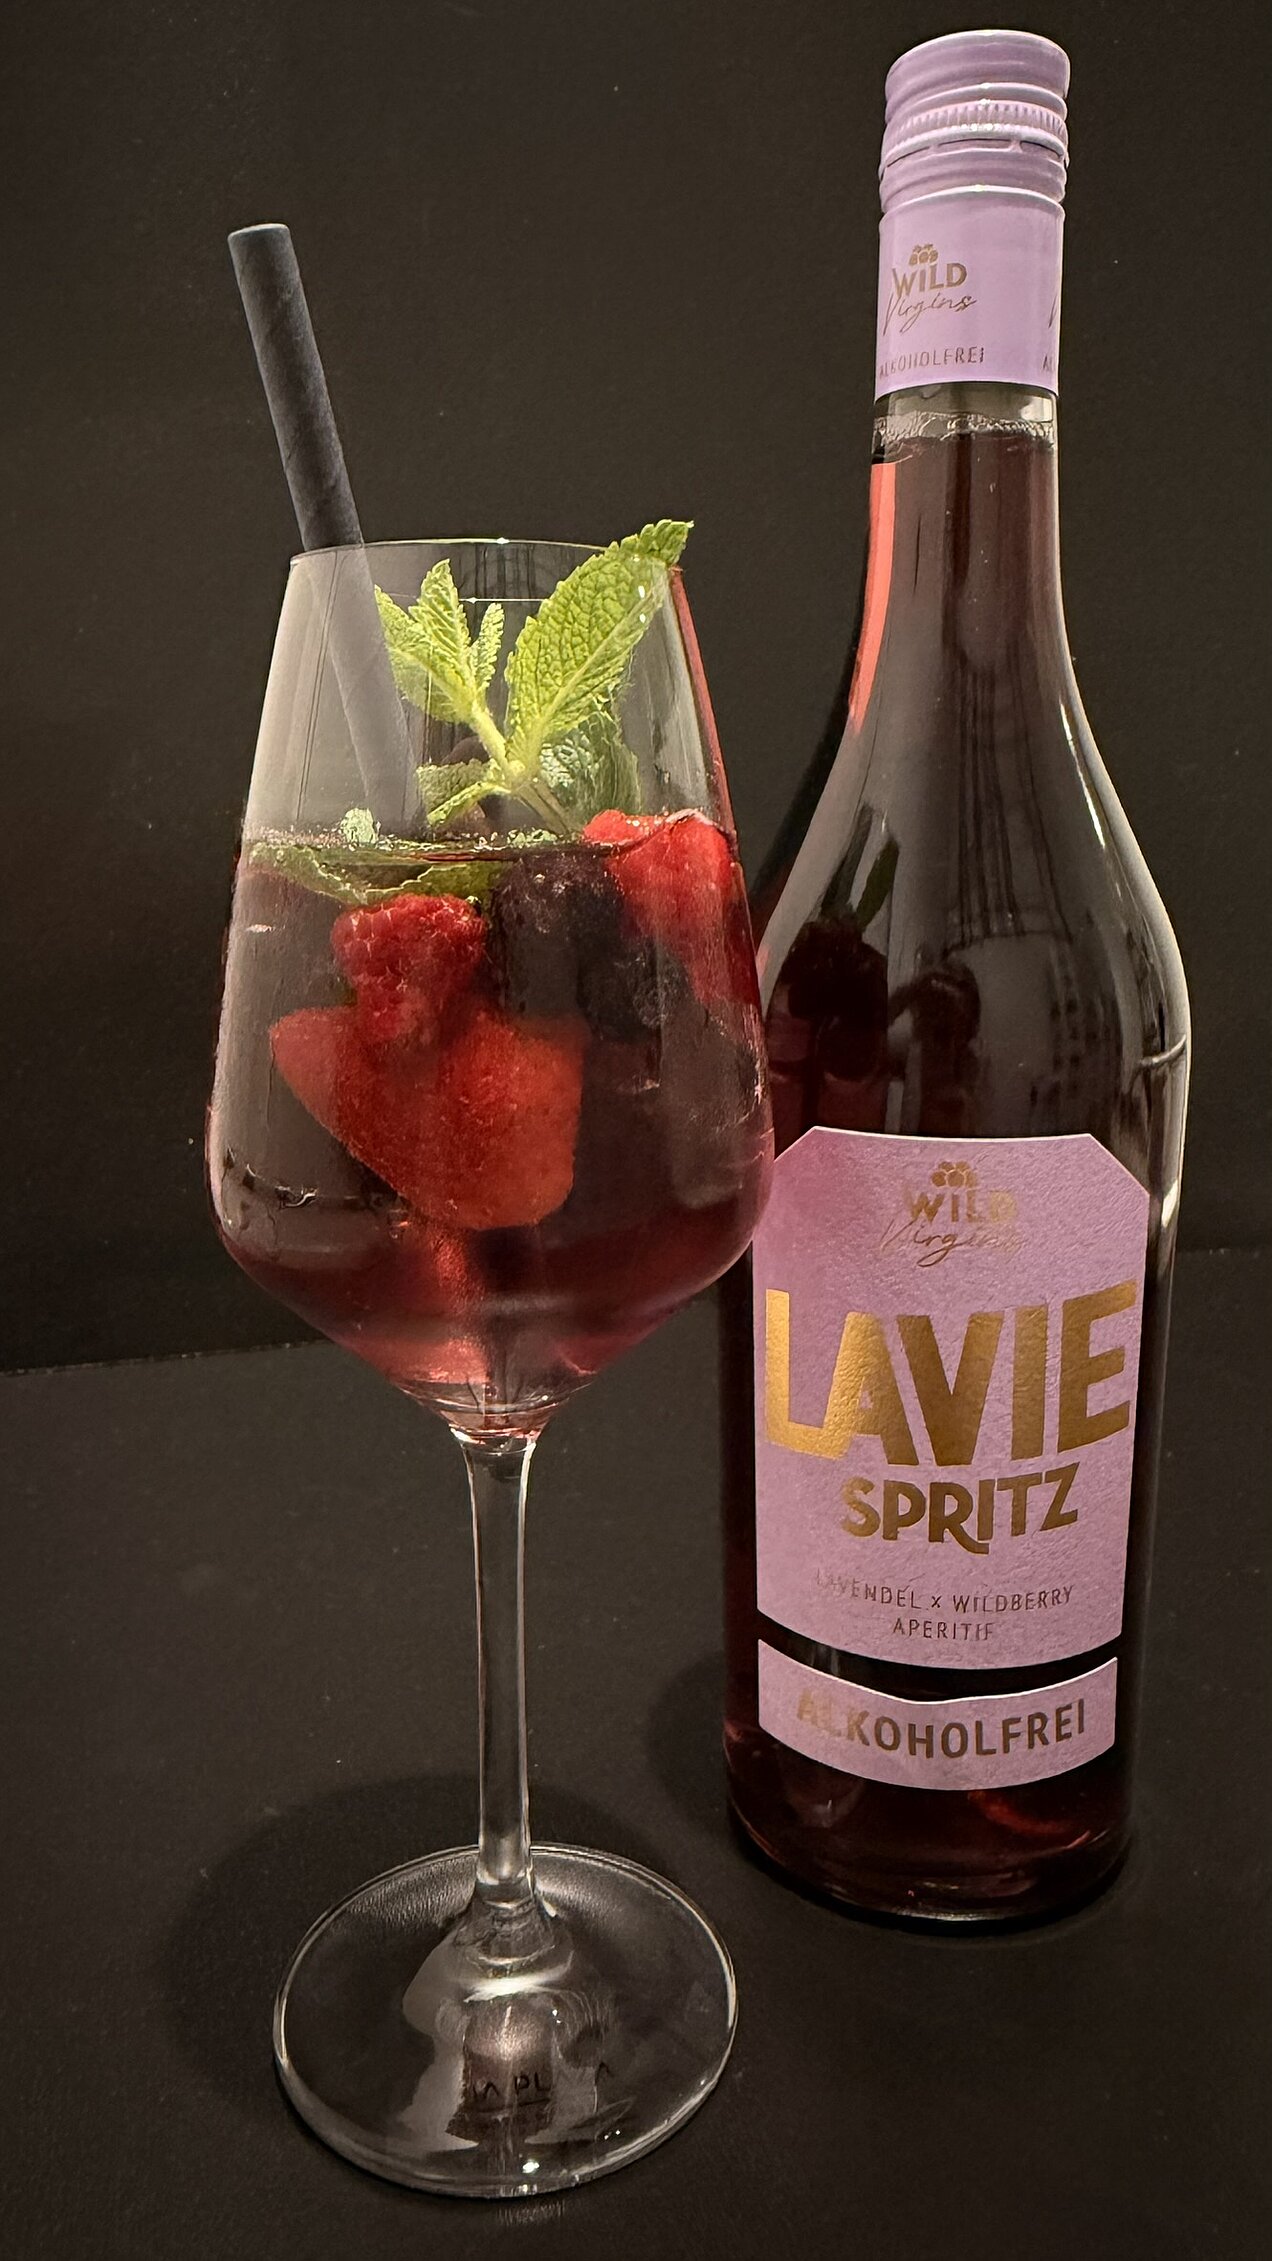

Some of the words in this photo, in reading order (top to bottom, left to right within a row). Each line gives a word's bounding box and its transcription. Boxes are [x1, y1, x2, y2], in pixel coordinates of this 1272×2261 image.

[892, 262, 968, 297] WILD
[882, 292, 977, 336] Virgins
[765, 1279, 1138, 1467] LAVIE
[840, 1461, 1081, 1555] SPRITZ
[953, 1584, 1075, 1614] WILDBERRY
[892, 1617, 995, 1641] APERITIF
[796, 1688, 1086, 1760] ALKOHOLFREI
